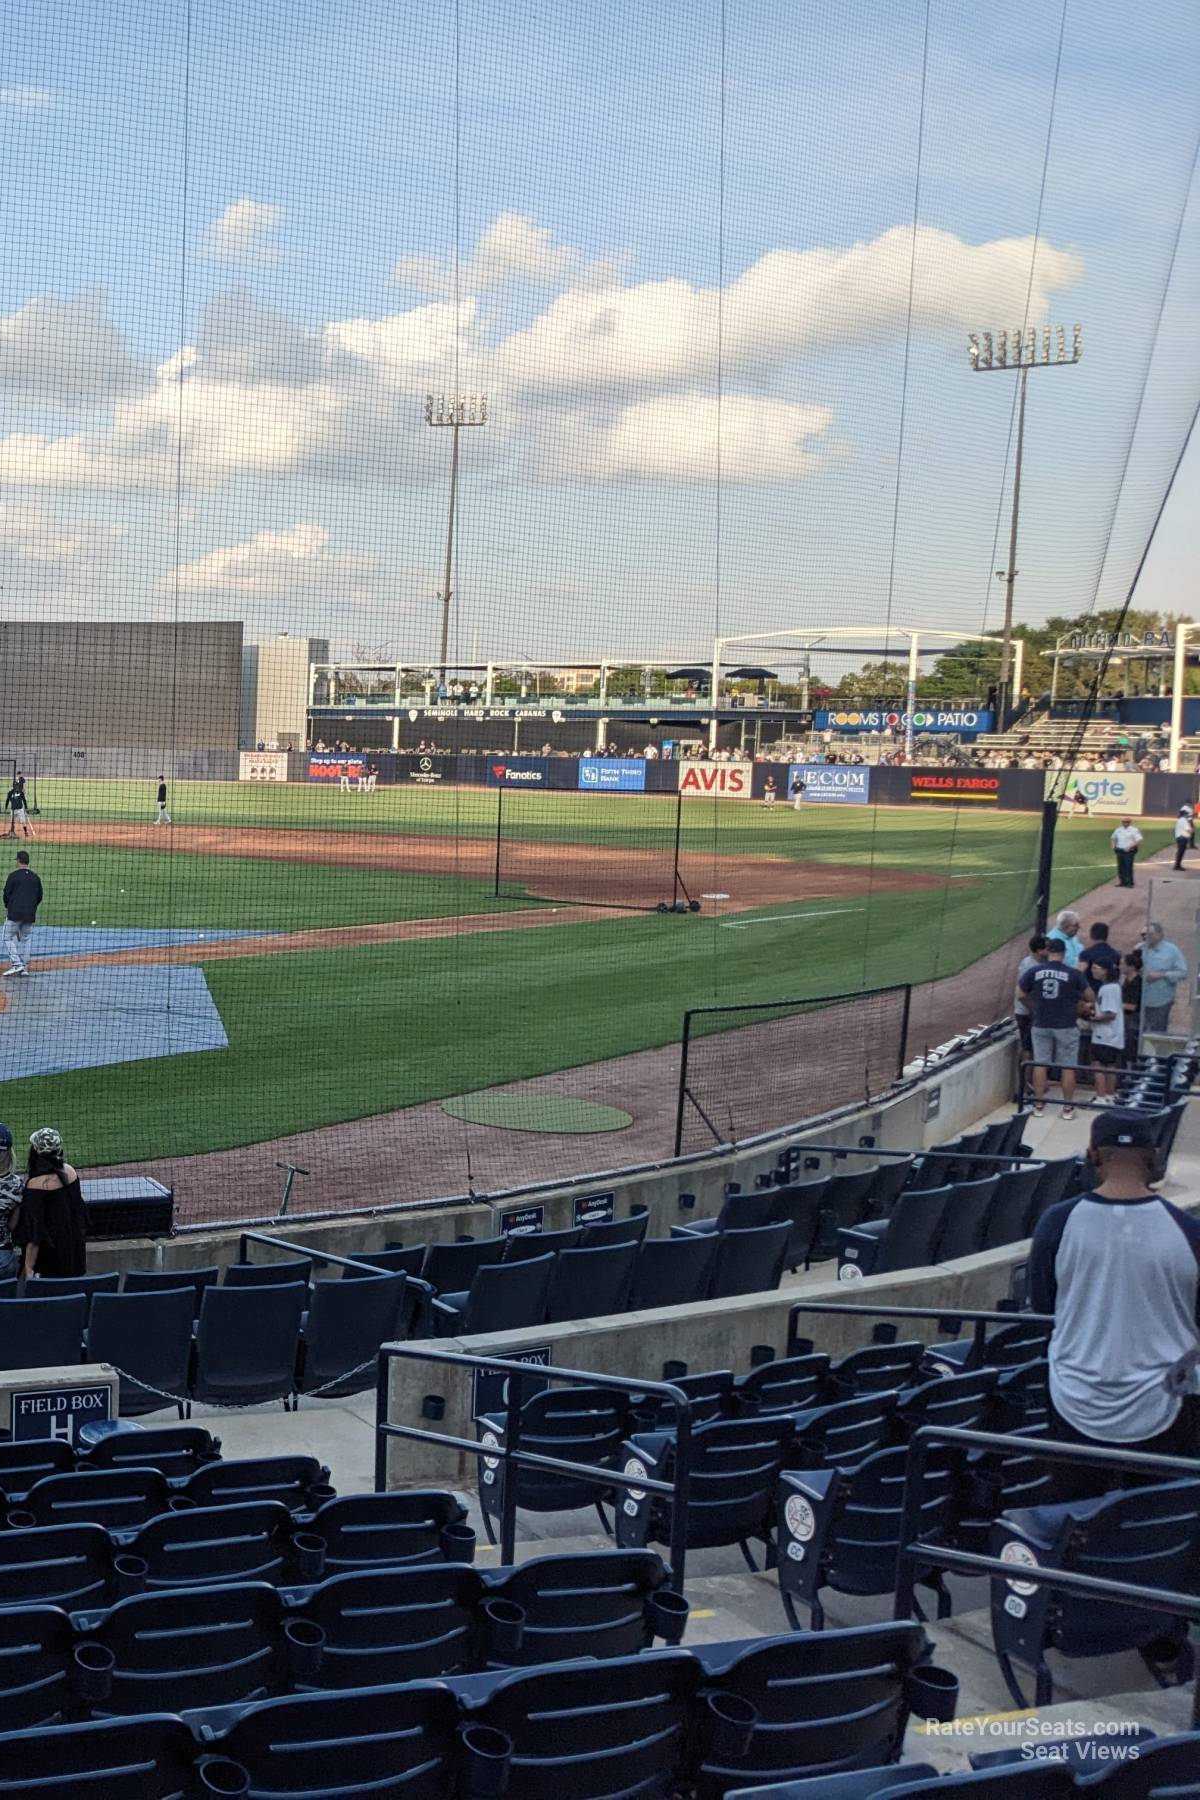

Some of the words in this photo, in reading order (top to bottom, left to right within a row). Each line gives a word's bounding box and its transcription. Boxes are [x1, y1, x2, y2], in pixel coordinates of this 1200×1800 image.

[1143, 631, 1170, 648] BA
[827, 712, 879, 727] ROOMS
[882, 712, 899, 726] TO
[901, 712, 926, 726] GO
[938, 712, 978, 727] PATIO
[505, 769, 542, 780] Fanatics
[681, 767, 744, 792] AVIS
[912, 777, 953, 788] WELLS
[956, 777, 999, 789] FARGO
[1084, 779, 1125, 801] gte
[1042, 979, 1059, 999] 9
[20, 1397, 67, 1414] FIELD
[71, 1393, 104, 1410] BOX
[50, 1413, 74, 1446] H
